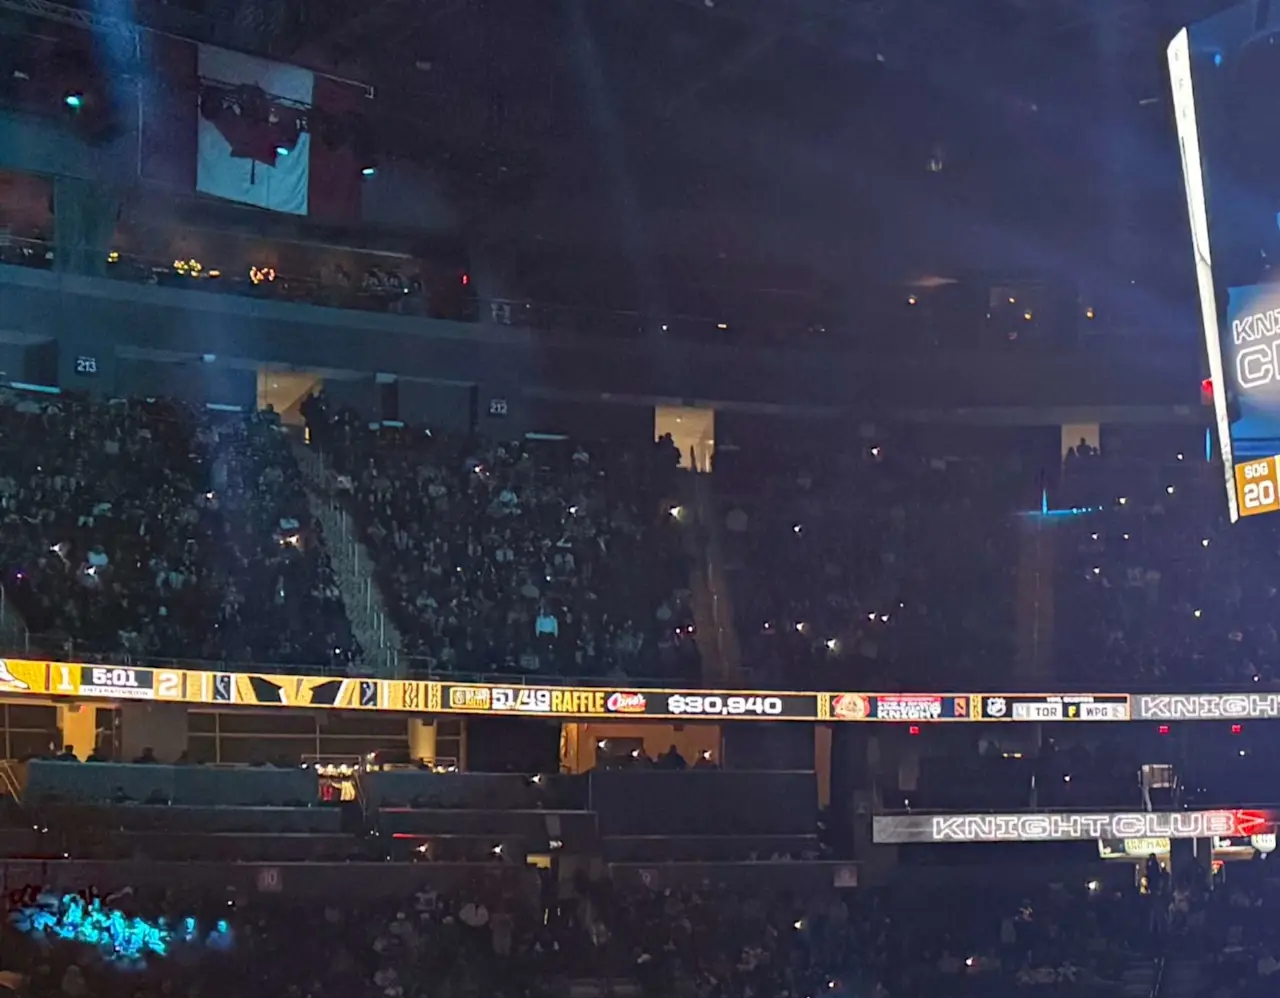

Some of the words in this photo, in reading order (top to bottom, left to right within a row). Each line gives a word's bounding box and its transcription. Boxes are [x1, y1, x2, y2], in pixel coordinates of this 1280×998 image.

[76, 359, 97, 373] 213
[1244, 462, 1269, 479] SOG
[1243, 480, 1275, 508] 20
[54, 666, 74, 691] 1
[92, 667, 138, 686] 5:01
[158, 672, 179, 696] 2
[551, 690, 604, 713] RAFFLE
[668, 693, 782, 715] $30,940
[1035, 707, 1058, 717] TOR
[1086, 707, 1108, 717] WPG
